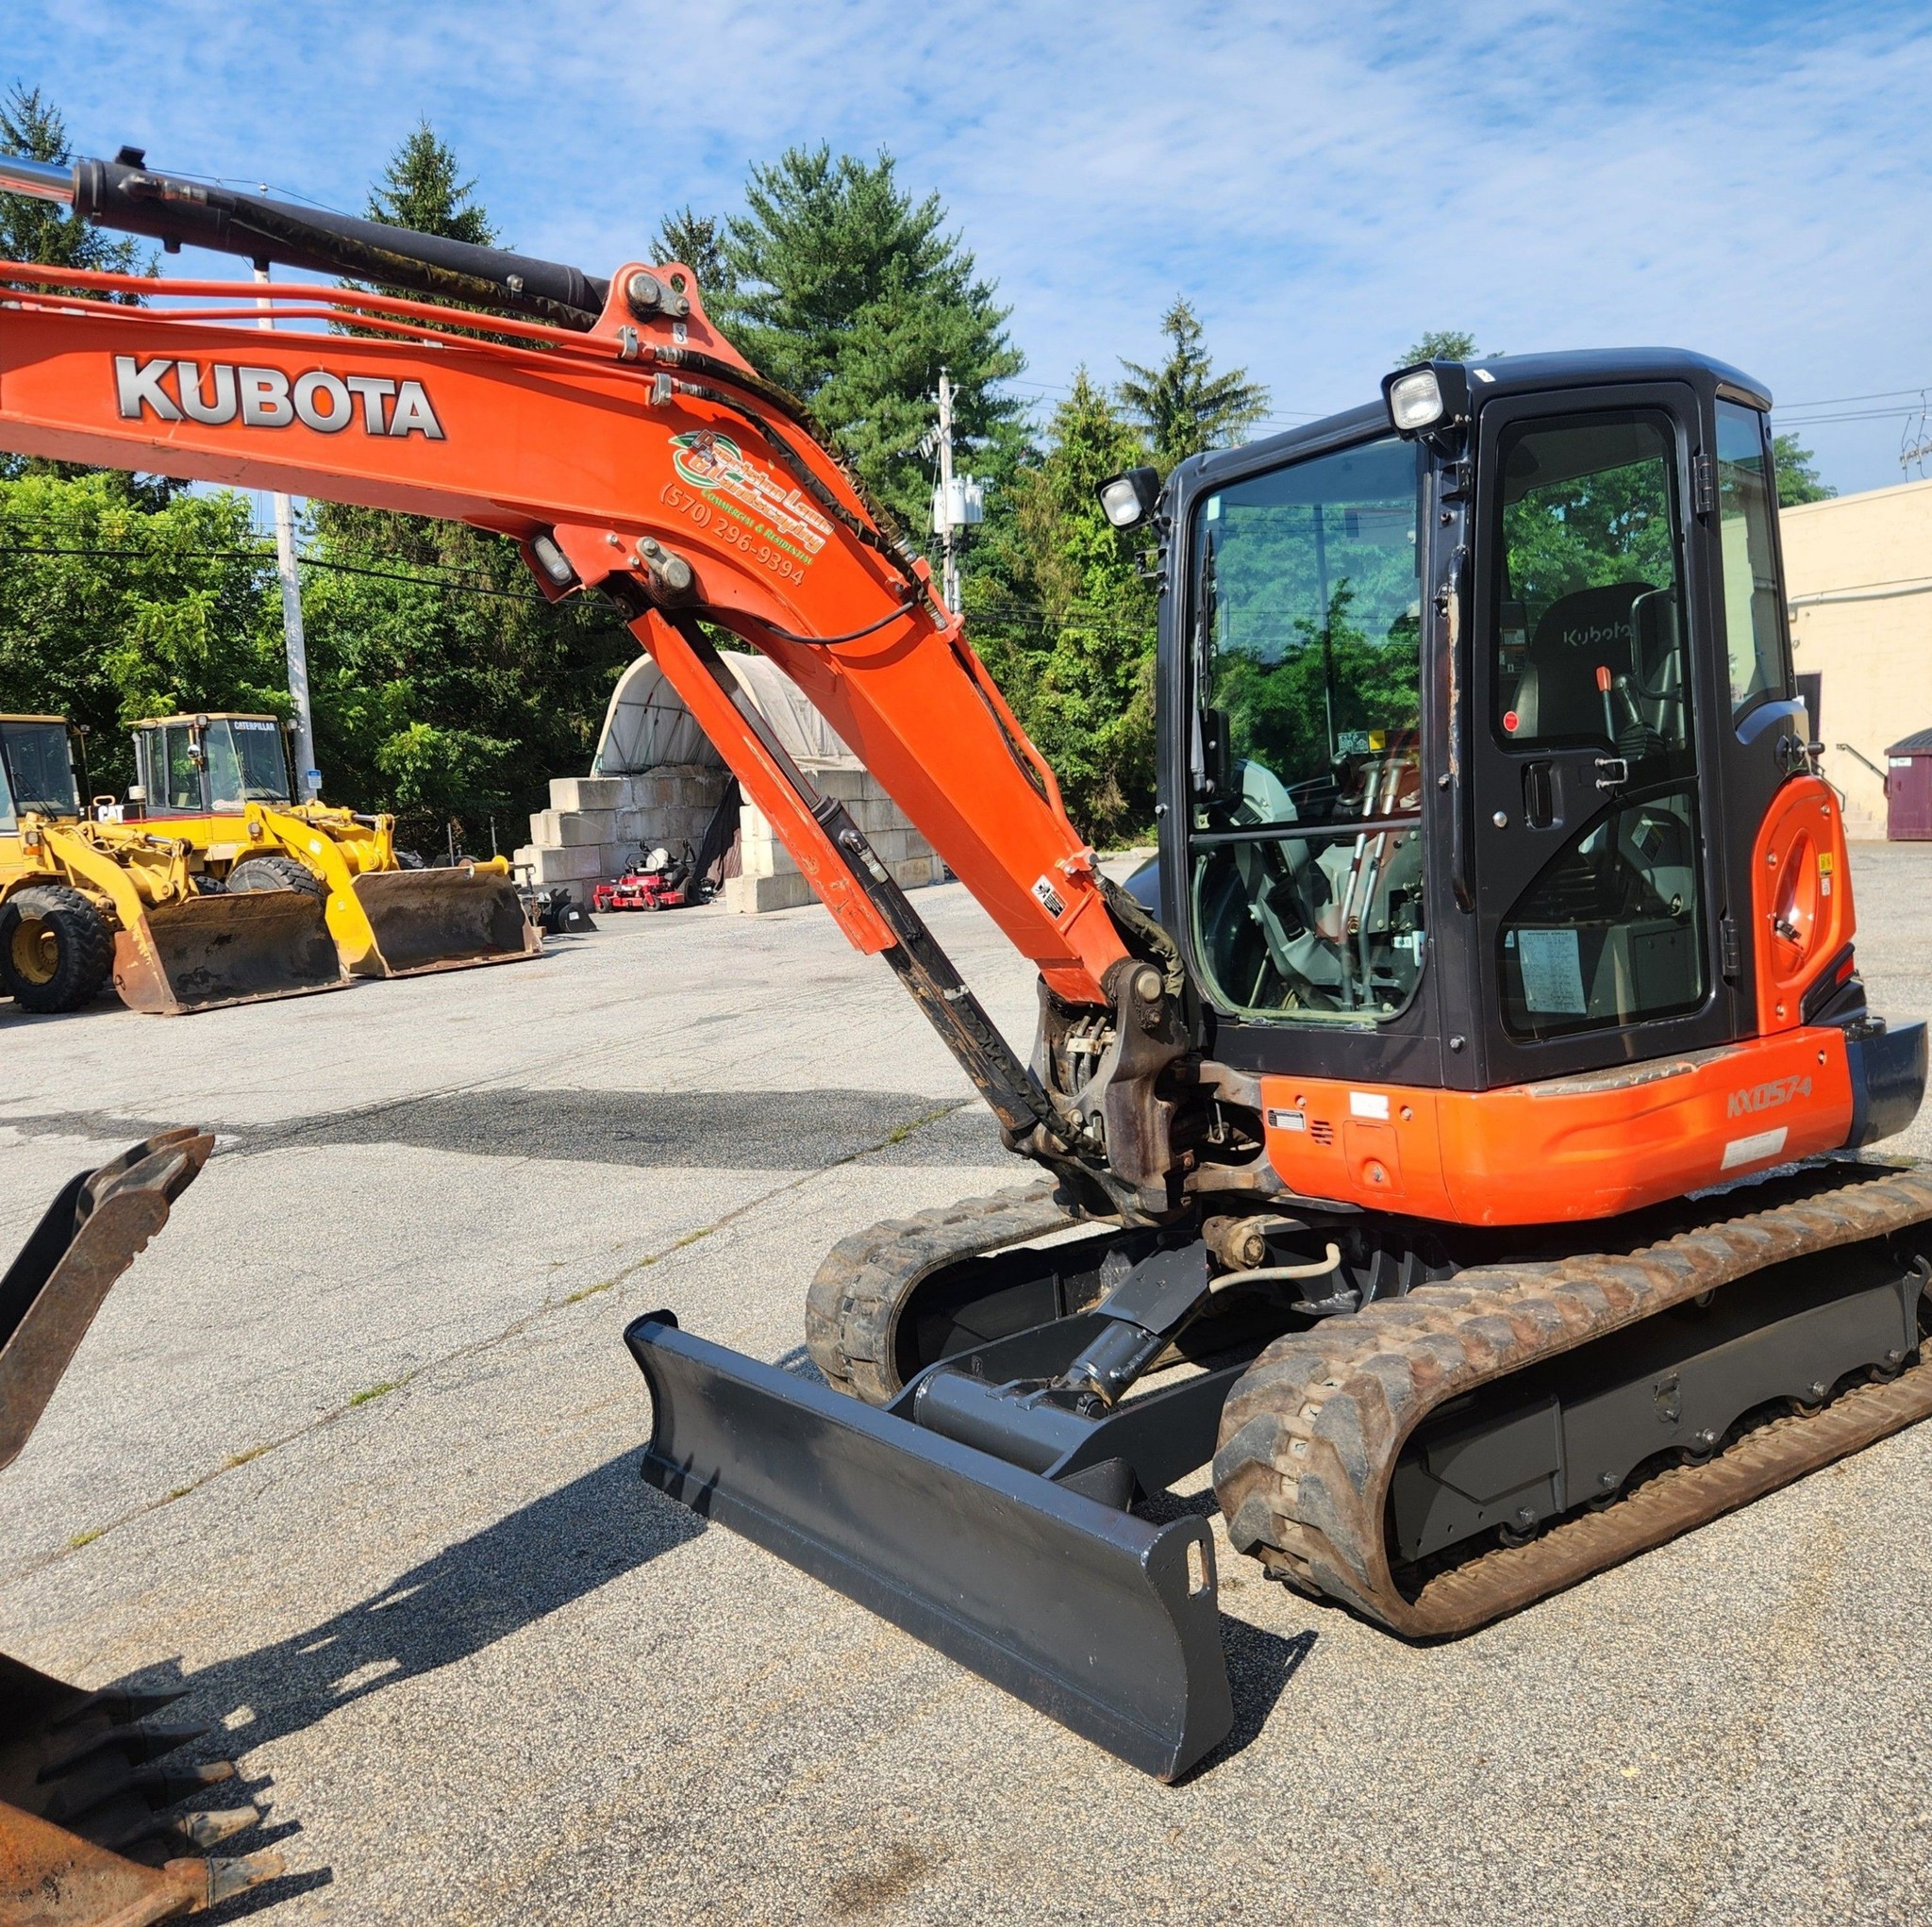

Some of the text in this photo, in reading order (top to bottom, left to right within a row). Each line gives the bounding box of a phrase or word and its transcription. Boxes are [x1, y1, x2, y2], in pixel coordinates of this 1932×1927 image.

[114, 355, 447, 440] KUBOTA
[691, 429, 836, 536] Precision Lawn
[708, 462, 826, 554] Landscaping
[659, 482, 807, 588] (570) 296-9394
[1563, 622, 1633, 647] Kubota
[233, 721, 275, 732] CATERPILLAR
[98, 805, 125, 823] CAT
